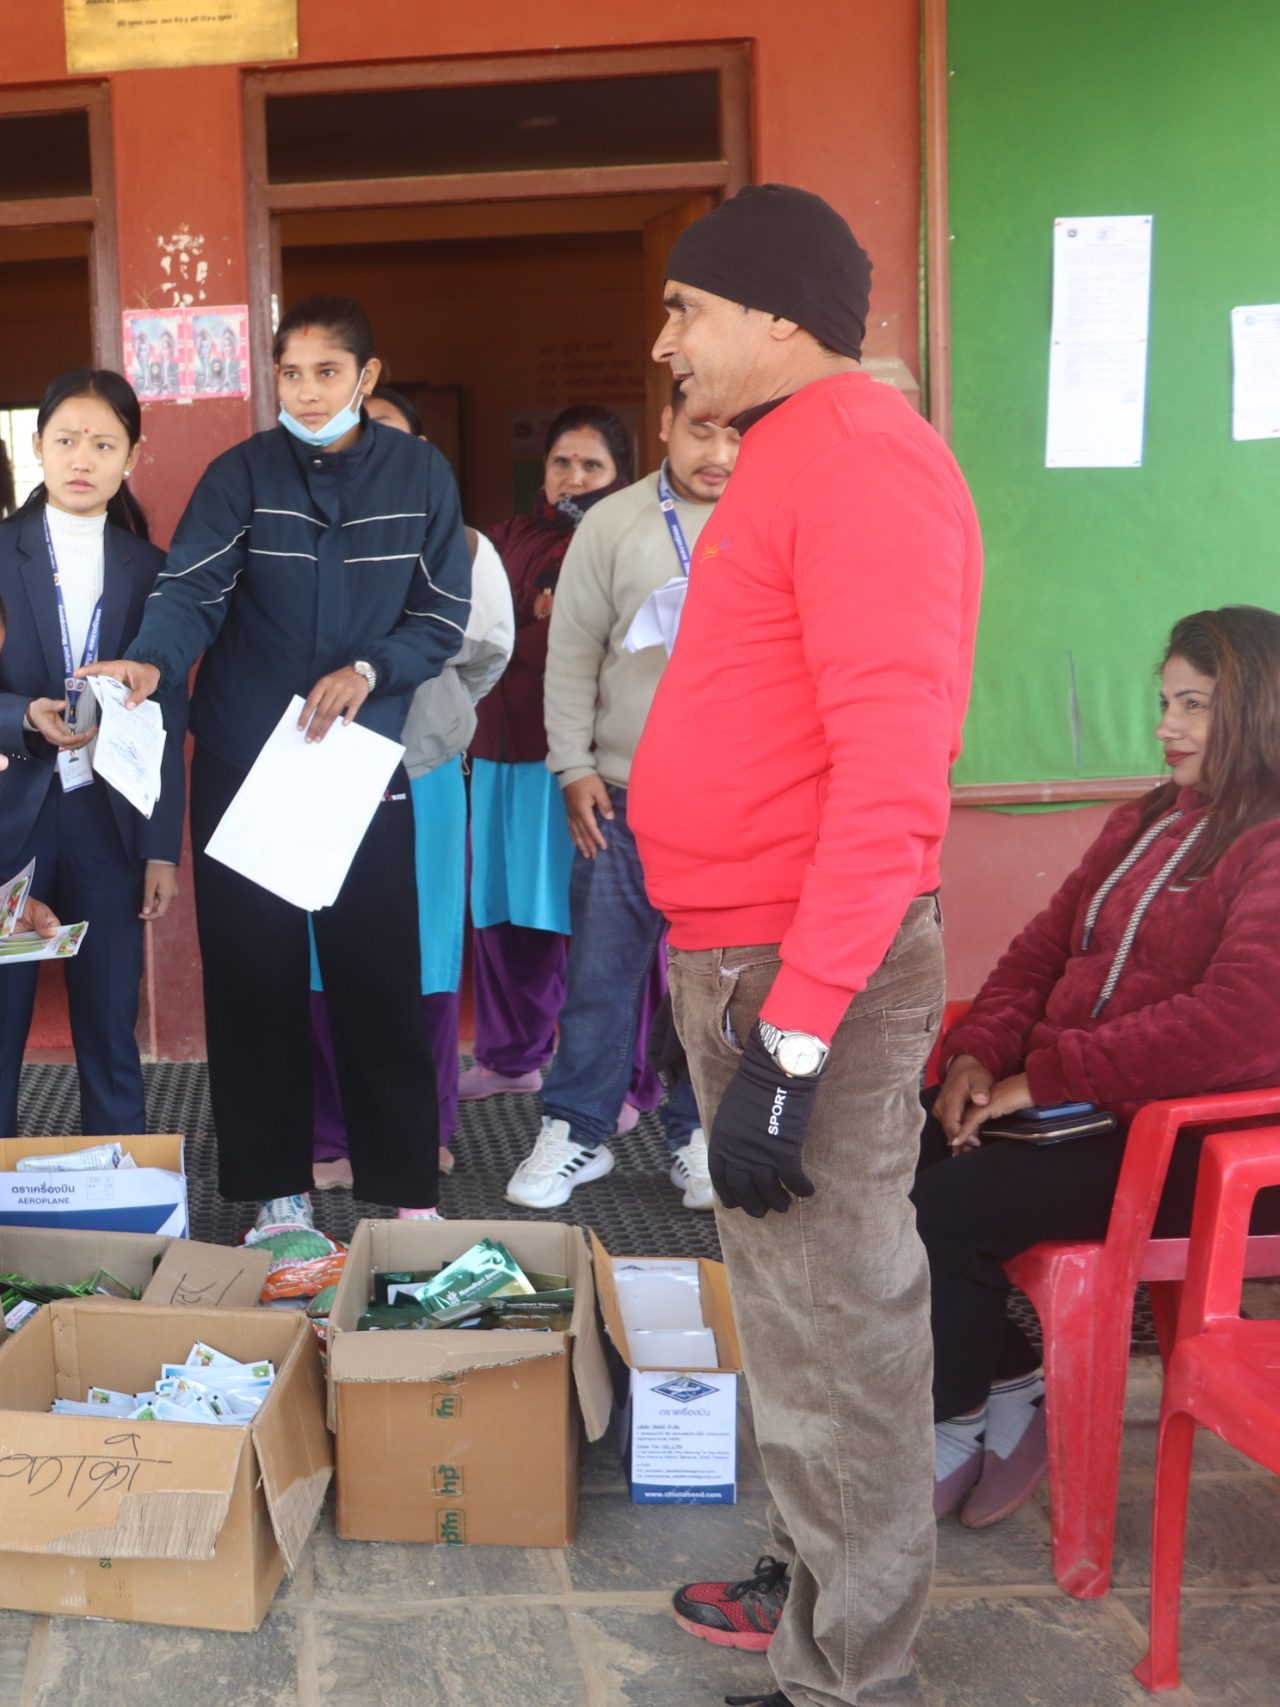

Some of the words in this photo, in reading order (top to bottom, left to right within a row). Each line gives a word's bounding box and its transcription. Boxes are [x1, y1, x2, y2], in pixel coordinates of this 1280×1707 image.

[768, 1086, 787, 1136] SPORT
[11, 1181, 75, 1194] ตราเครื่องบิน
[18, 1197, 70, 1205] AEROPLANE
[439, 1465, 461, 1494] hp
